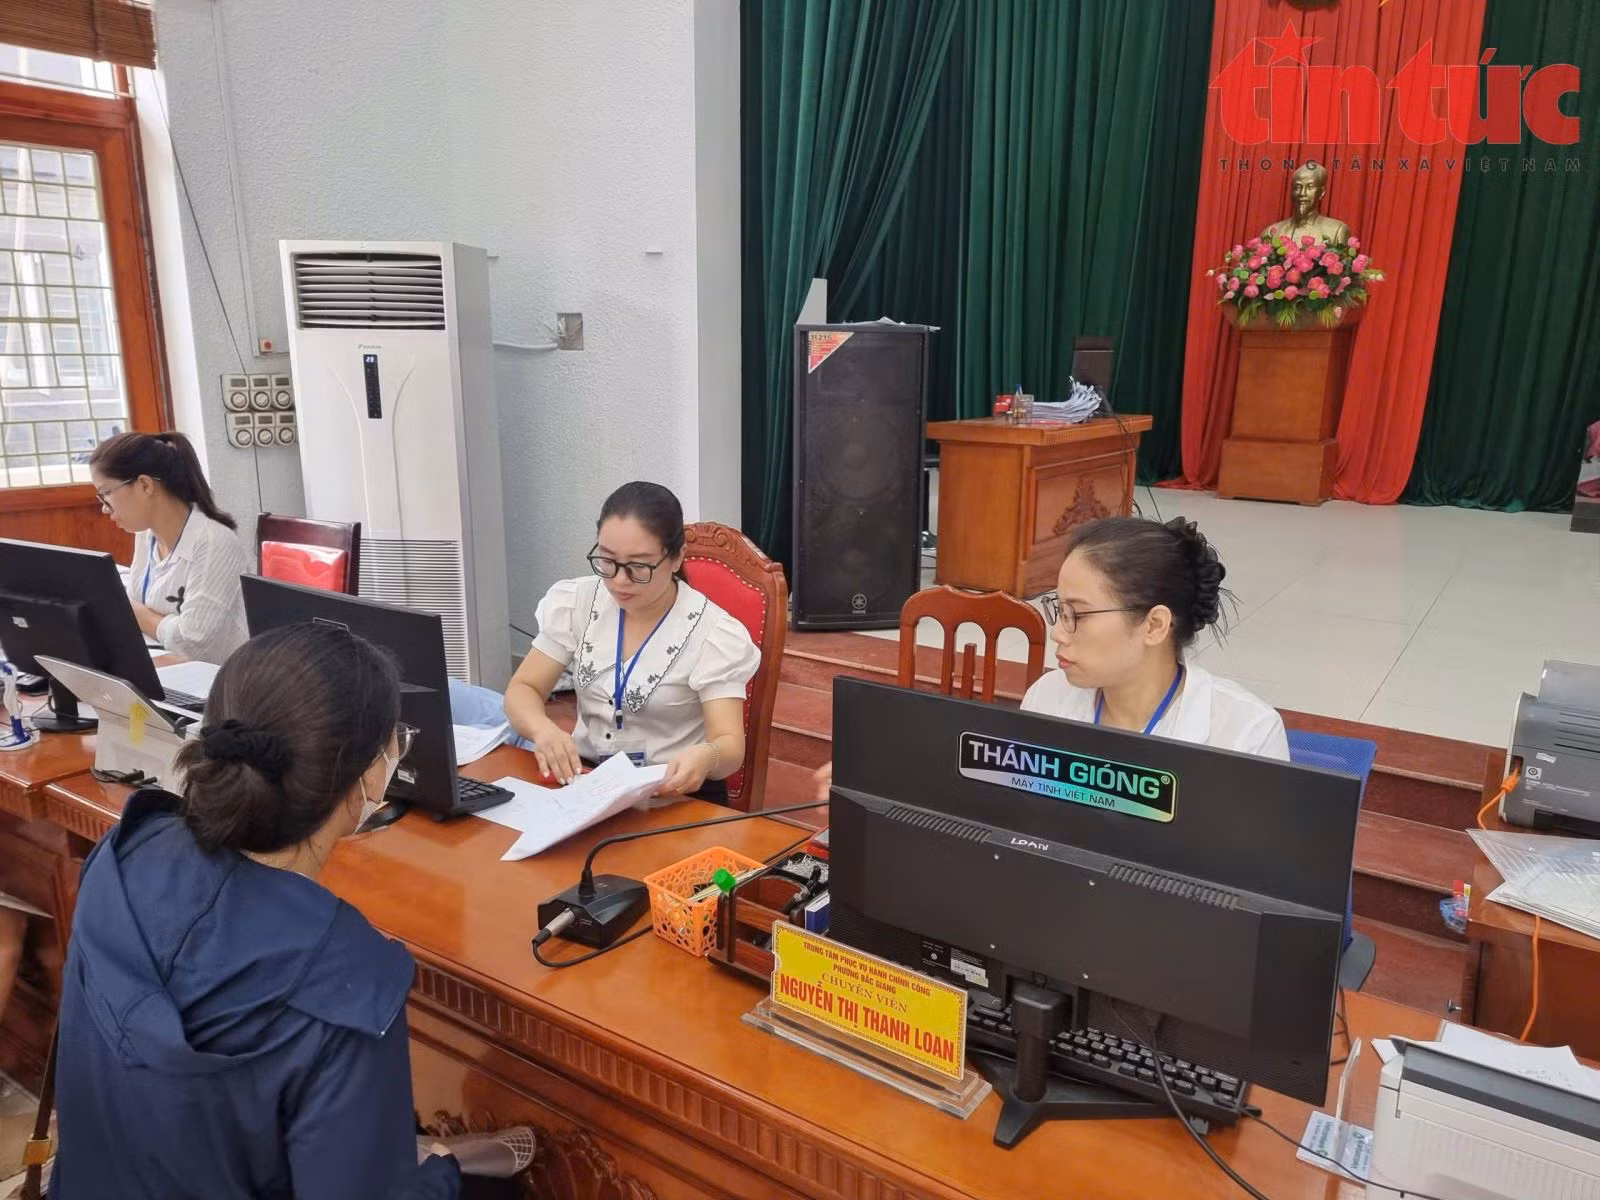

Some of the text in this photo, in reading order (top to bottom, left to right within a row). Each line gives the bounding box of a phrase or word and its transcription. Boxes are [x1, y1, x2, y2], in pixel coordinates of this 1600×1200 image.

[968, 740, 1060, 778] THÁNH
[1089, 794, 1116, 808] NAM
[1010, 837, 1049, 851] LOAN
[803, 942, 824, 955] TRUNG
[825, 949, 839, 961] TÂM
[821, 972, 908, 1013] CHUYÊN VIÊN
[875, 981, 897, 995] GIANG
[780, 973, 955, 1064] NGUYỄN THỊ THANH LOAN
